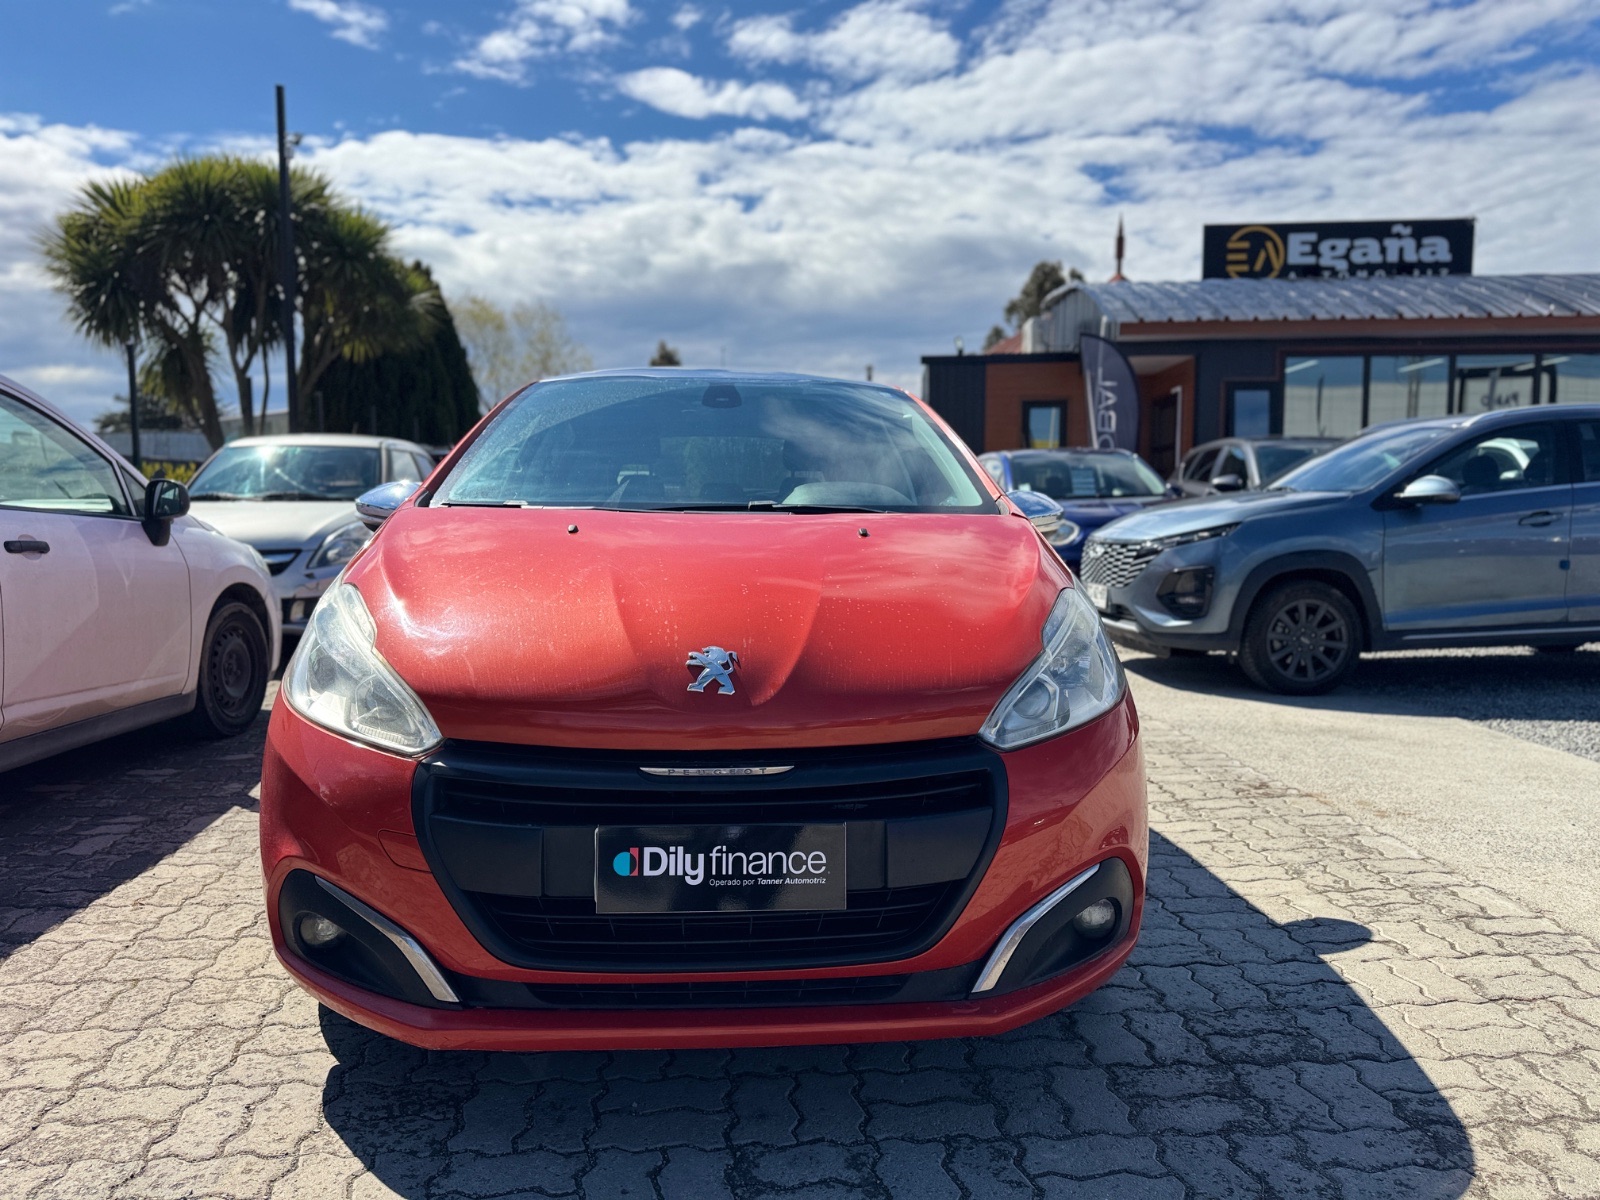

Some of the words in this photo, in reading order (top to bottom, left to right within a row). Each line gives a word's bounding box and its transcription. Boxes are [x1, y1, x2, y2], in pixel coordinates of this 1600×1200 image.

[1286, 223, 1453, 271] Egaña
[667, 767, 767, 776] PEUGEOT
[643, 846, 704, 886] Dily
[709, 845, 827, 876] finance
[709, 878, 741, 887] Operado
[742, 879, 755, 887] por
[784, 877, 827, 885] Automotriz
